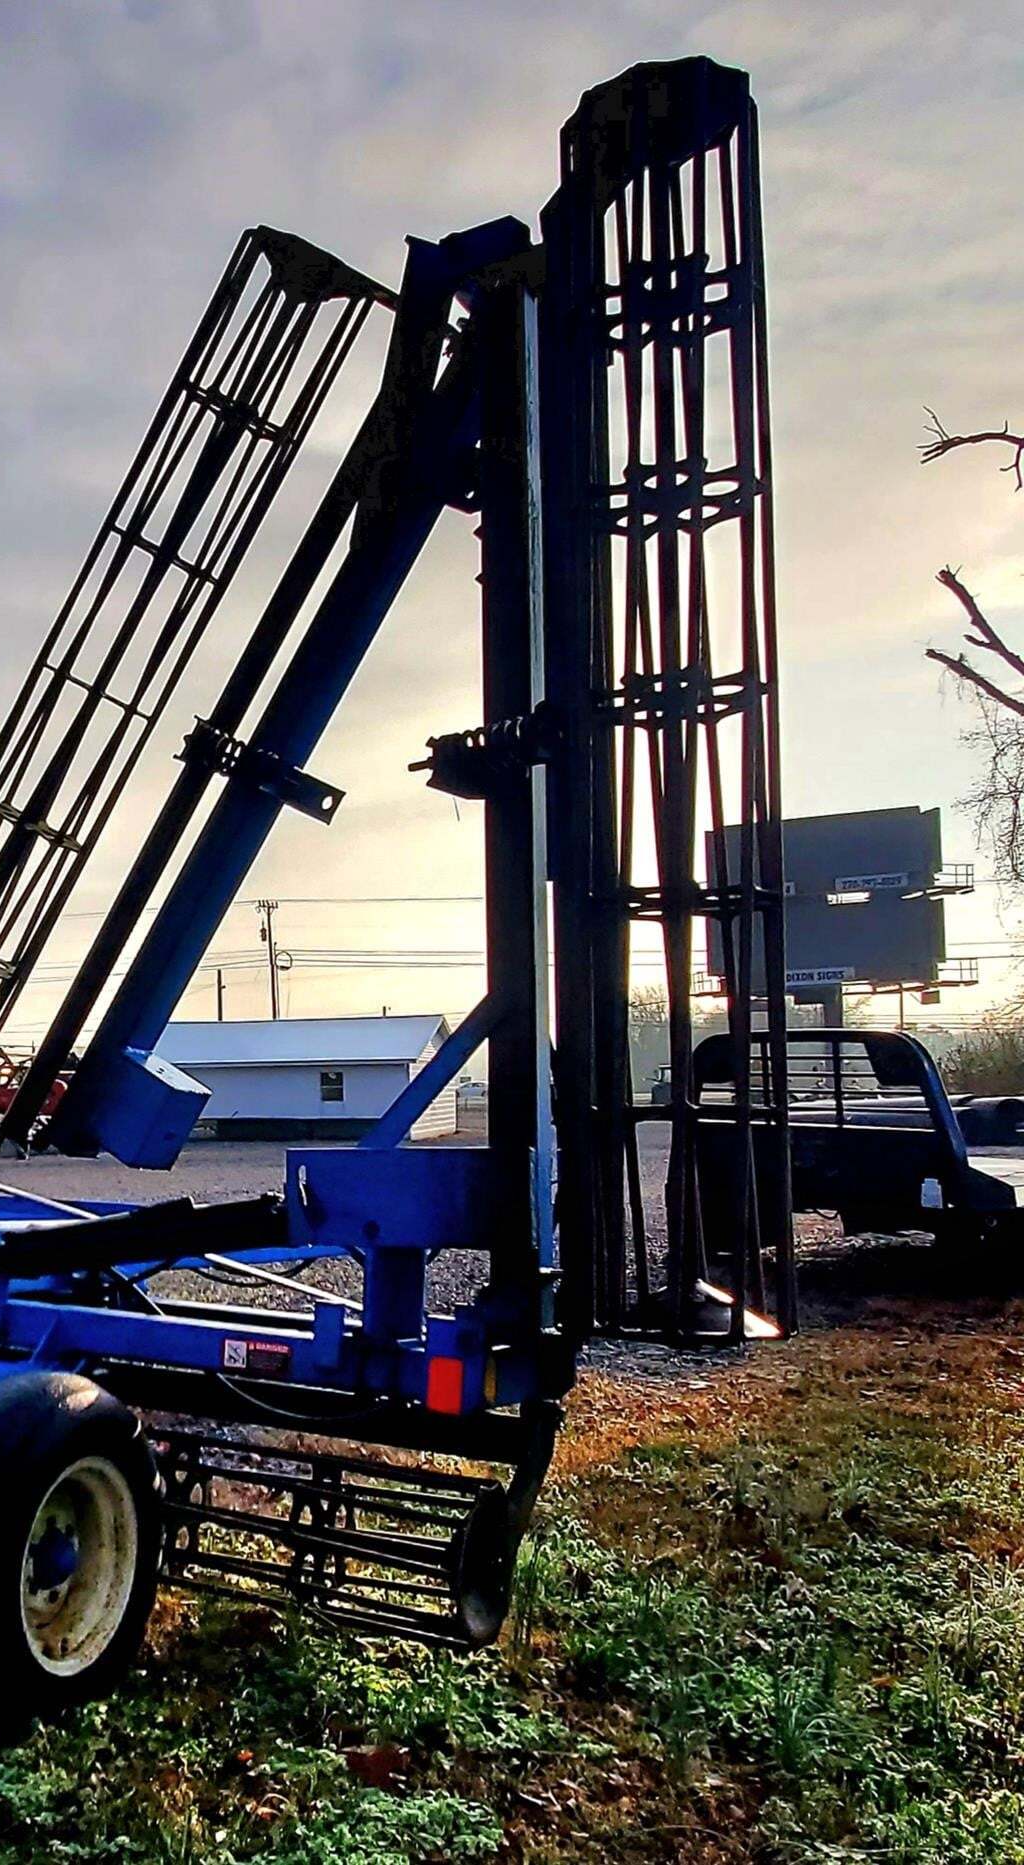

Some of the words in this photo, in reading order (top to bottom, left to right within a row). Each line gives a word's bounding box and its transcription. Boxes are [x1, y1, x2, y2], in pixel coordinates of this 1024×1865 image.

[786, 972, 815, 983] DIXON
[816, 970, 845, 981] SIGNS
[255, 1342, 289, 1354] DANGER
